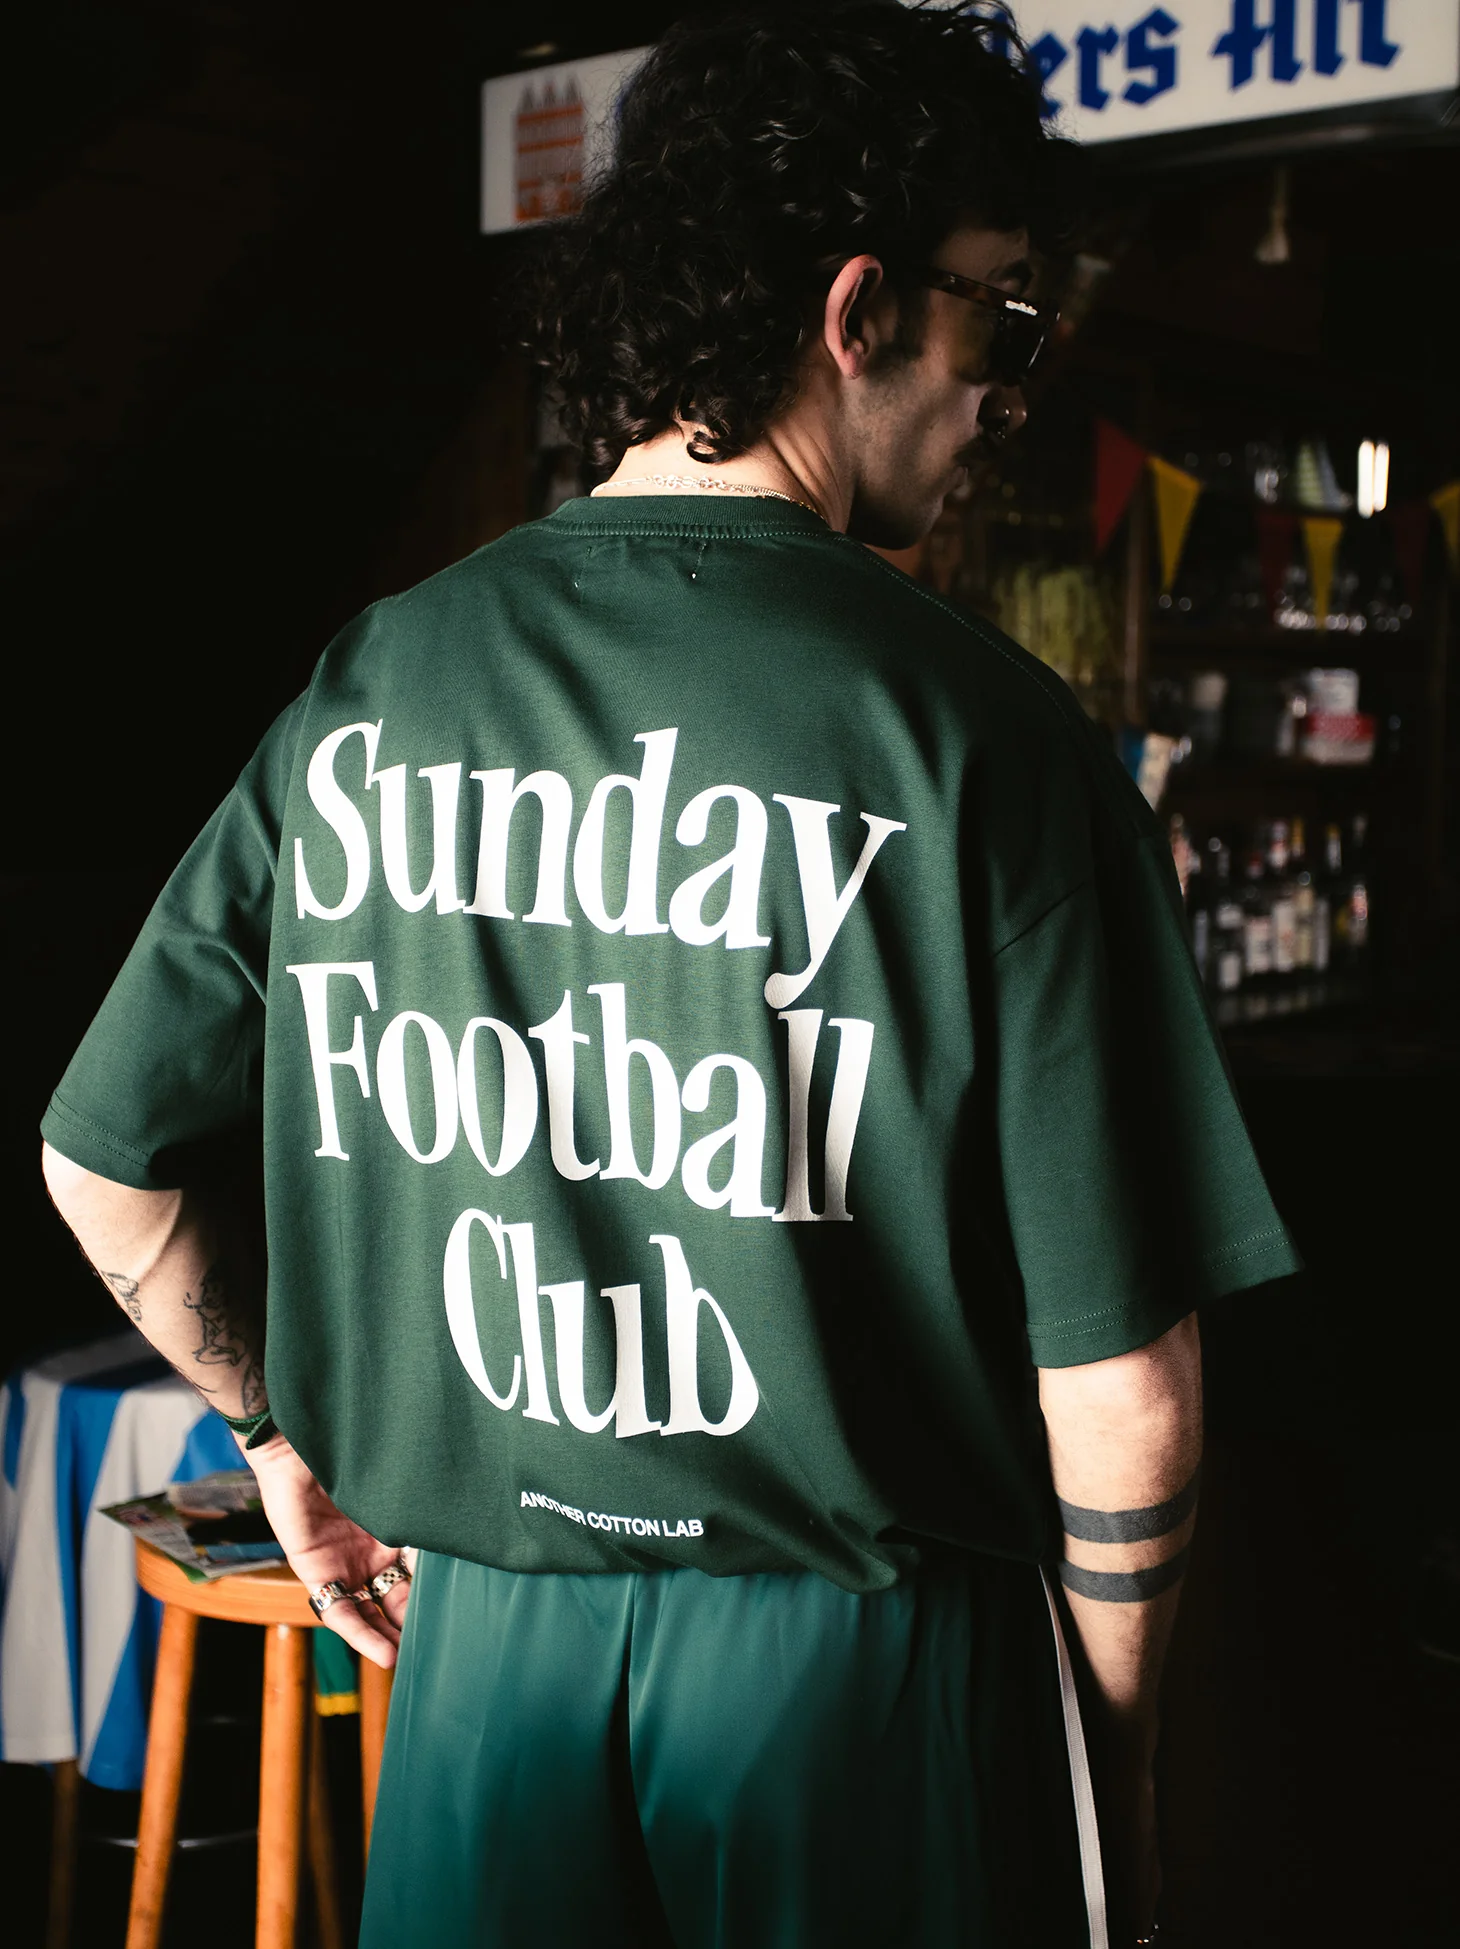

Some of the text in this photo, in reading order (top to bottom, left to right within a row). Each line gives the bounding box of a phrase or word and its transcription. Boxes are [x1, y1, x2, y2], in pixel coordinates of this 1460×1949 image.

[294, 718, 908, 1009] Sunday
[286, 961, 875, 1222] Football
[443, 1208, 760, 1438] Club
[520, 1491, 704, 1537] ANOTHER COTTON LAB
